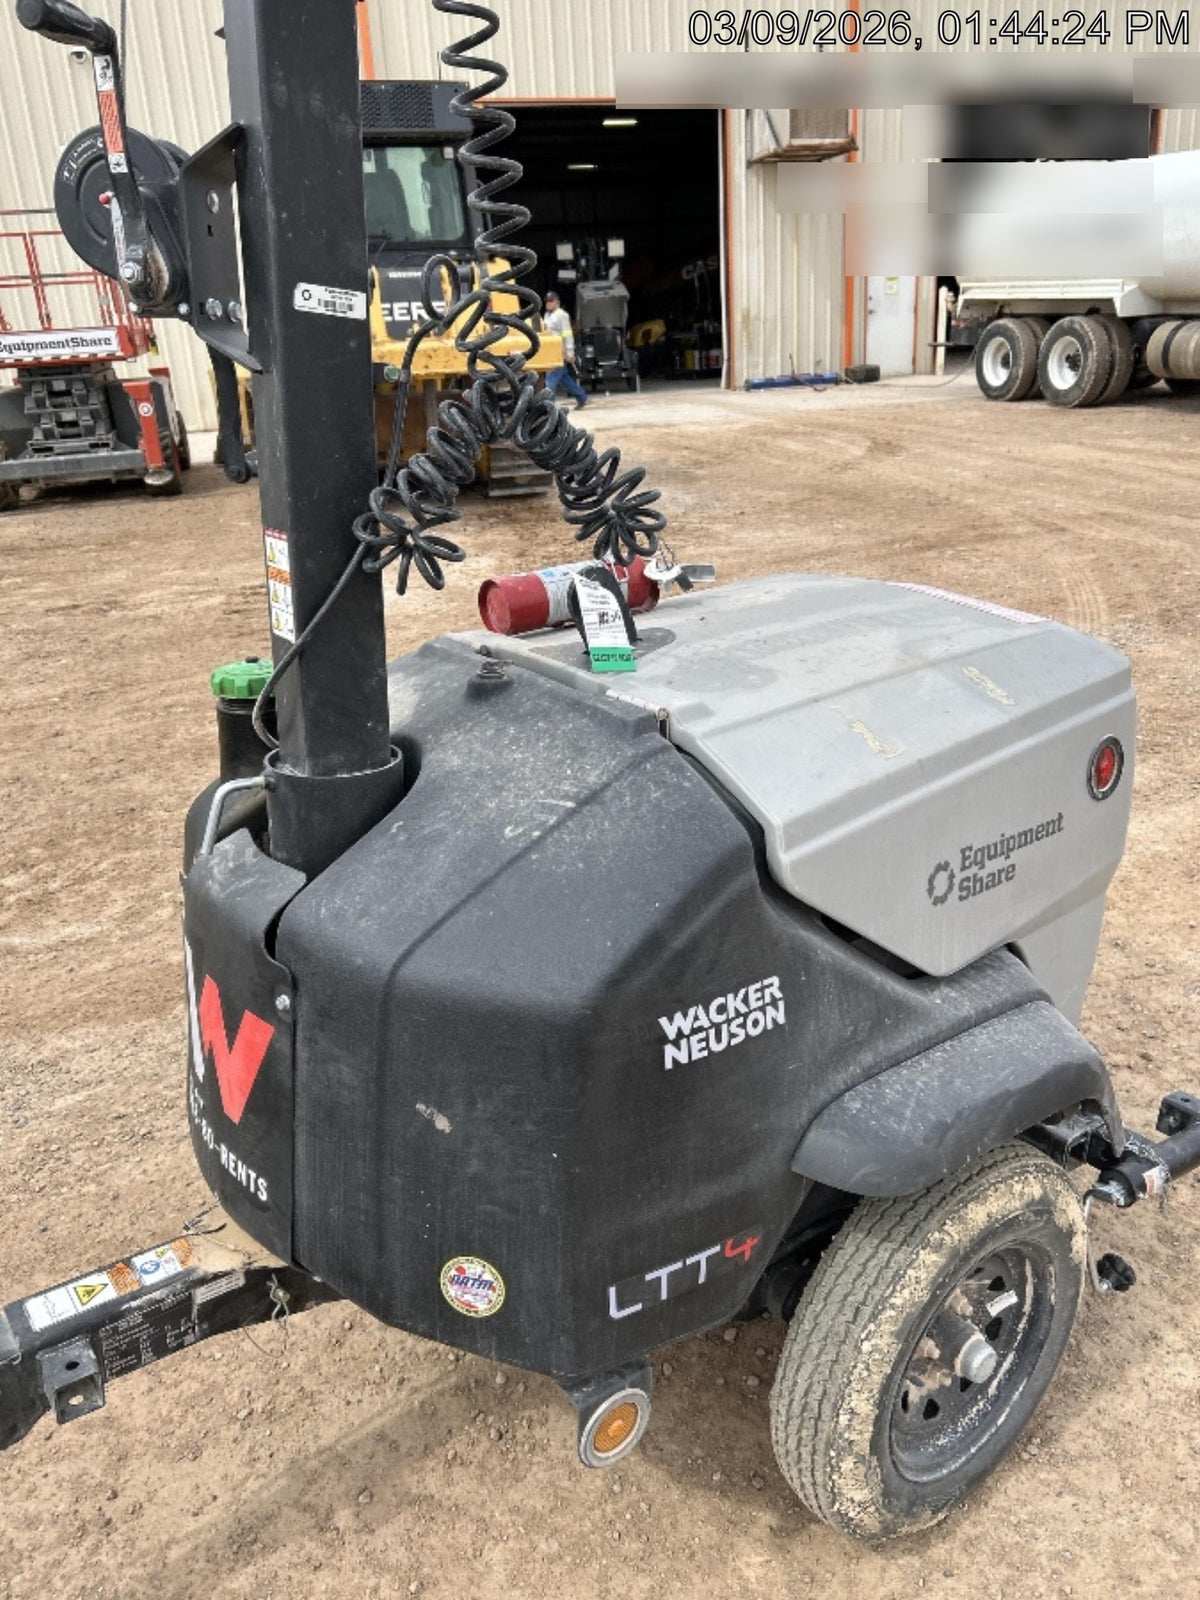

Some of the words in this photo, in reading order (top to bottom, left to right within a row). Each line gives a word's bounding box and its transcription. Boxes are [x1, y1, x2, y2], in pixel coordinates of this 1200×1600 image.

[960, 811, 1065, 872] Equipment
[957, 862, 1017, 902] Share
[657, 975, 783, 1041] WACKER
[664, 1000, 786, 1071] NEUSON
